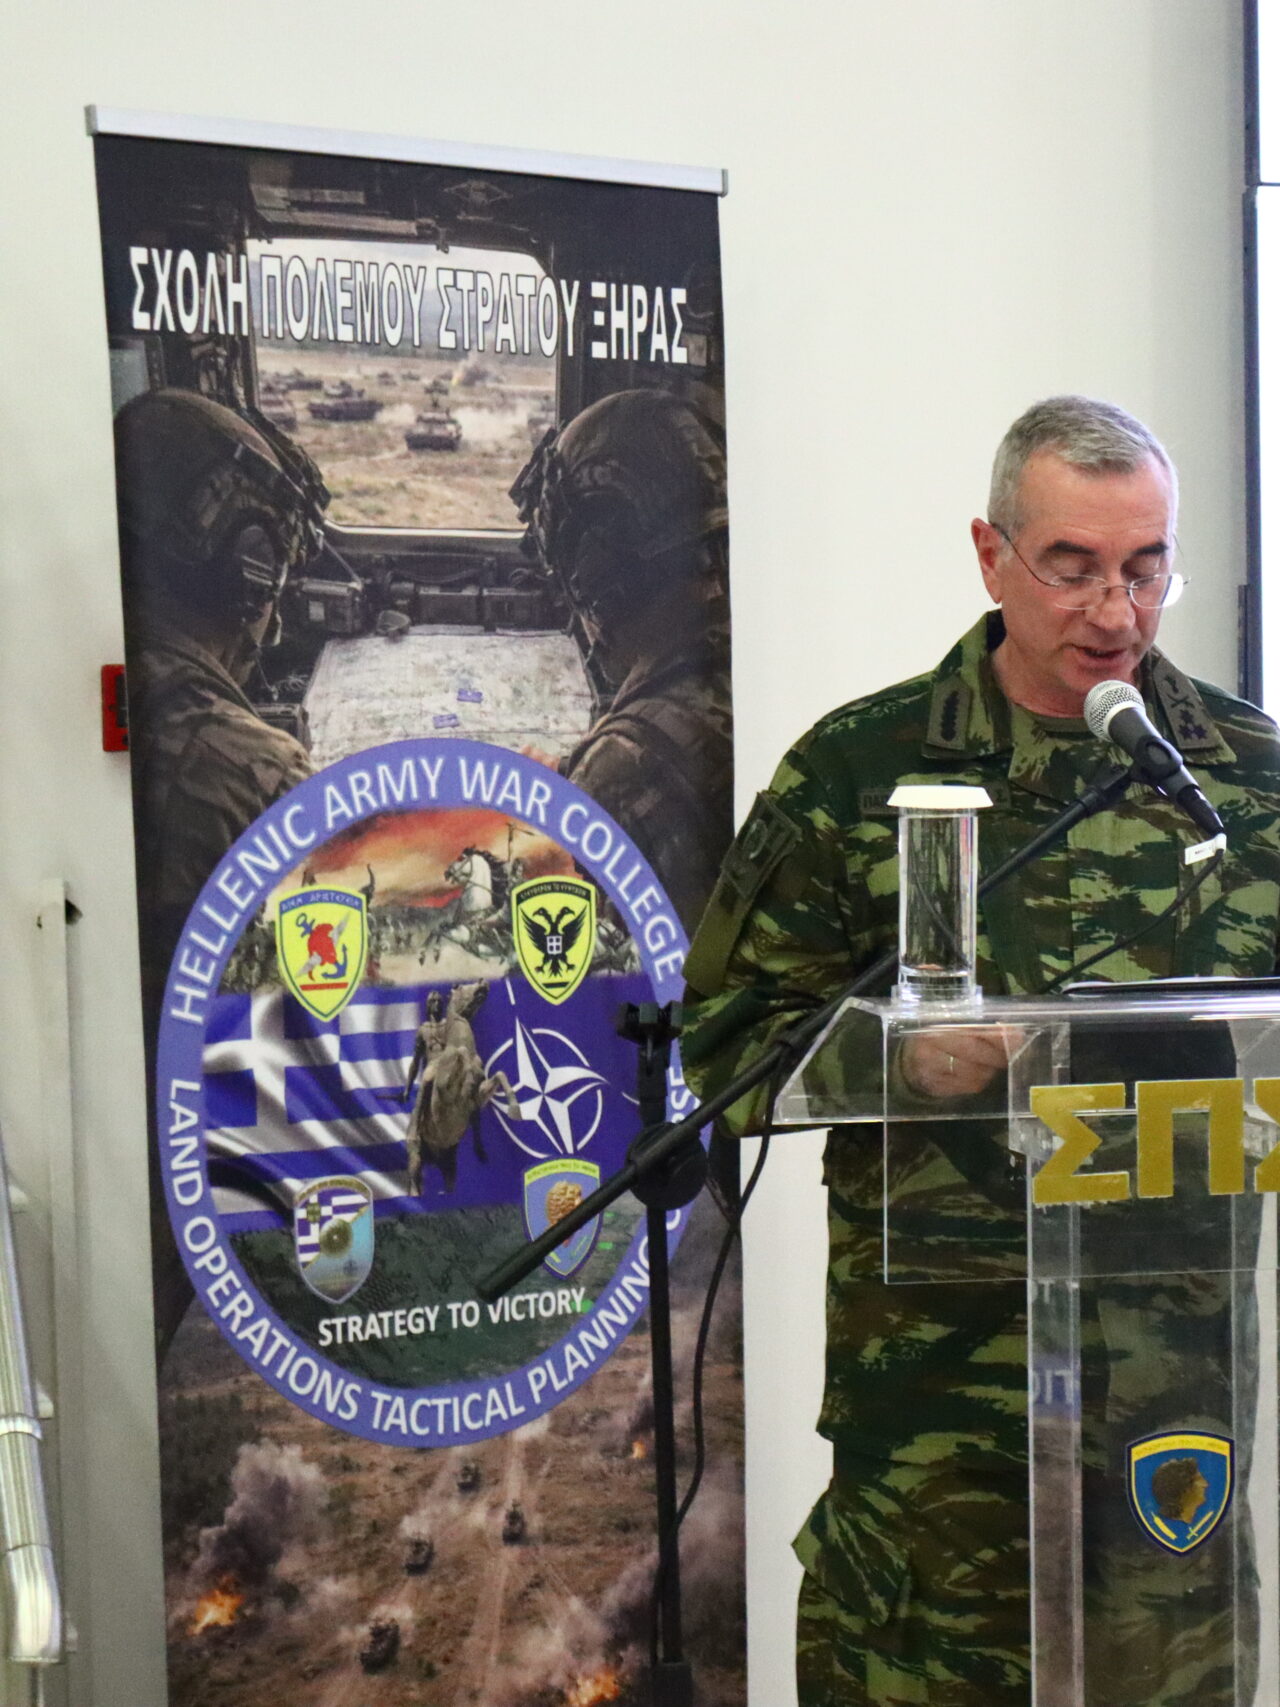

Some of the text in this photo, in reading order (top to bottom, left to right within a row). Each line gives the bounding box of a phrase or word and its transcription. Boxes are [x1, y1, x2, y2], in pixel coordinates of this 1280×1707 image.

[129, 246, 688, 364] ΣΧΟΛΗ ΠΟΛΕΜΟΥ ΣΤΡΑΤΟΥ ΞΗΡΑΣ
[171, 757, 686, 1024] HELLENIC ARMY WAR COLLEGE
[169, 1078, 205, 1207] LAND
[183, 1217, 361, 1421] OPERATIONS
[318, 1287, 586, 1347] STRATEGY TO VICTORY
[370, 1388, 526, 1436] TACTICAL
